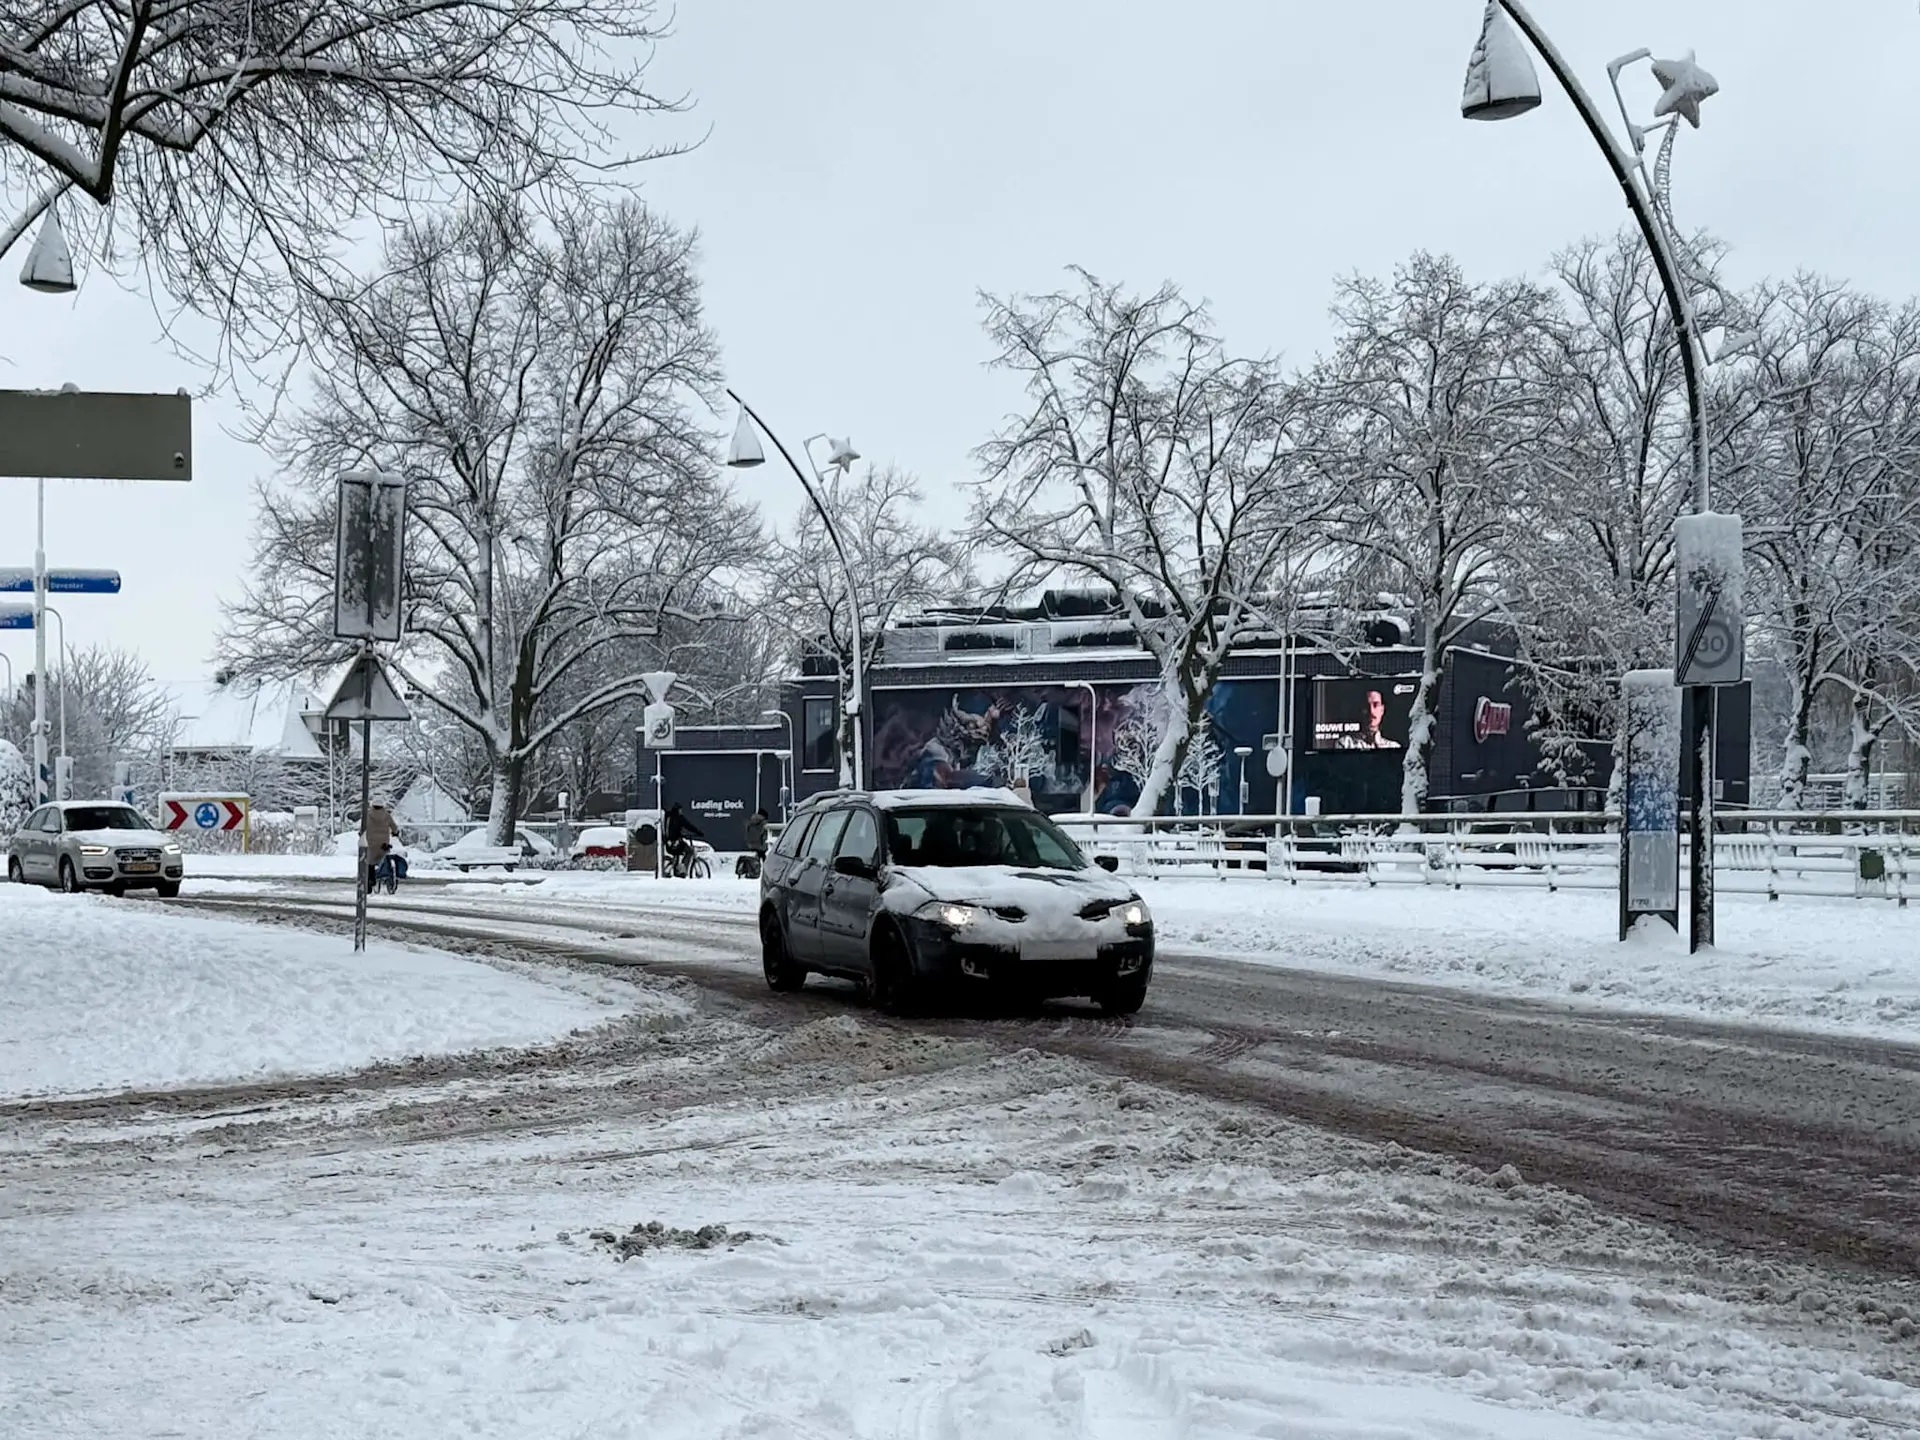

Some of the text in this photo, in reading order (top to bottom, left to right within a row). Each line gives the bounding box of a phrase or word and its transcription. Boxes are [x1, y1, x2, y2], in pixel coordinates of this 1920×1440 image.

[1697, 635, 1724, 652] 30
[691, 799, 744, 811] Loading Dock
